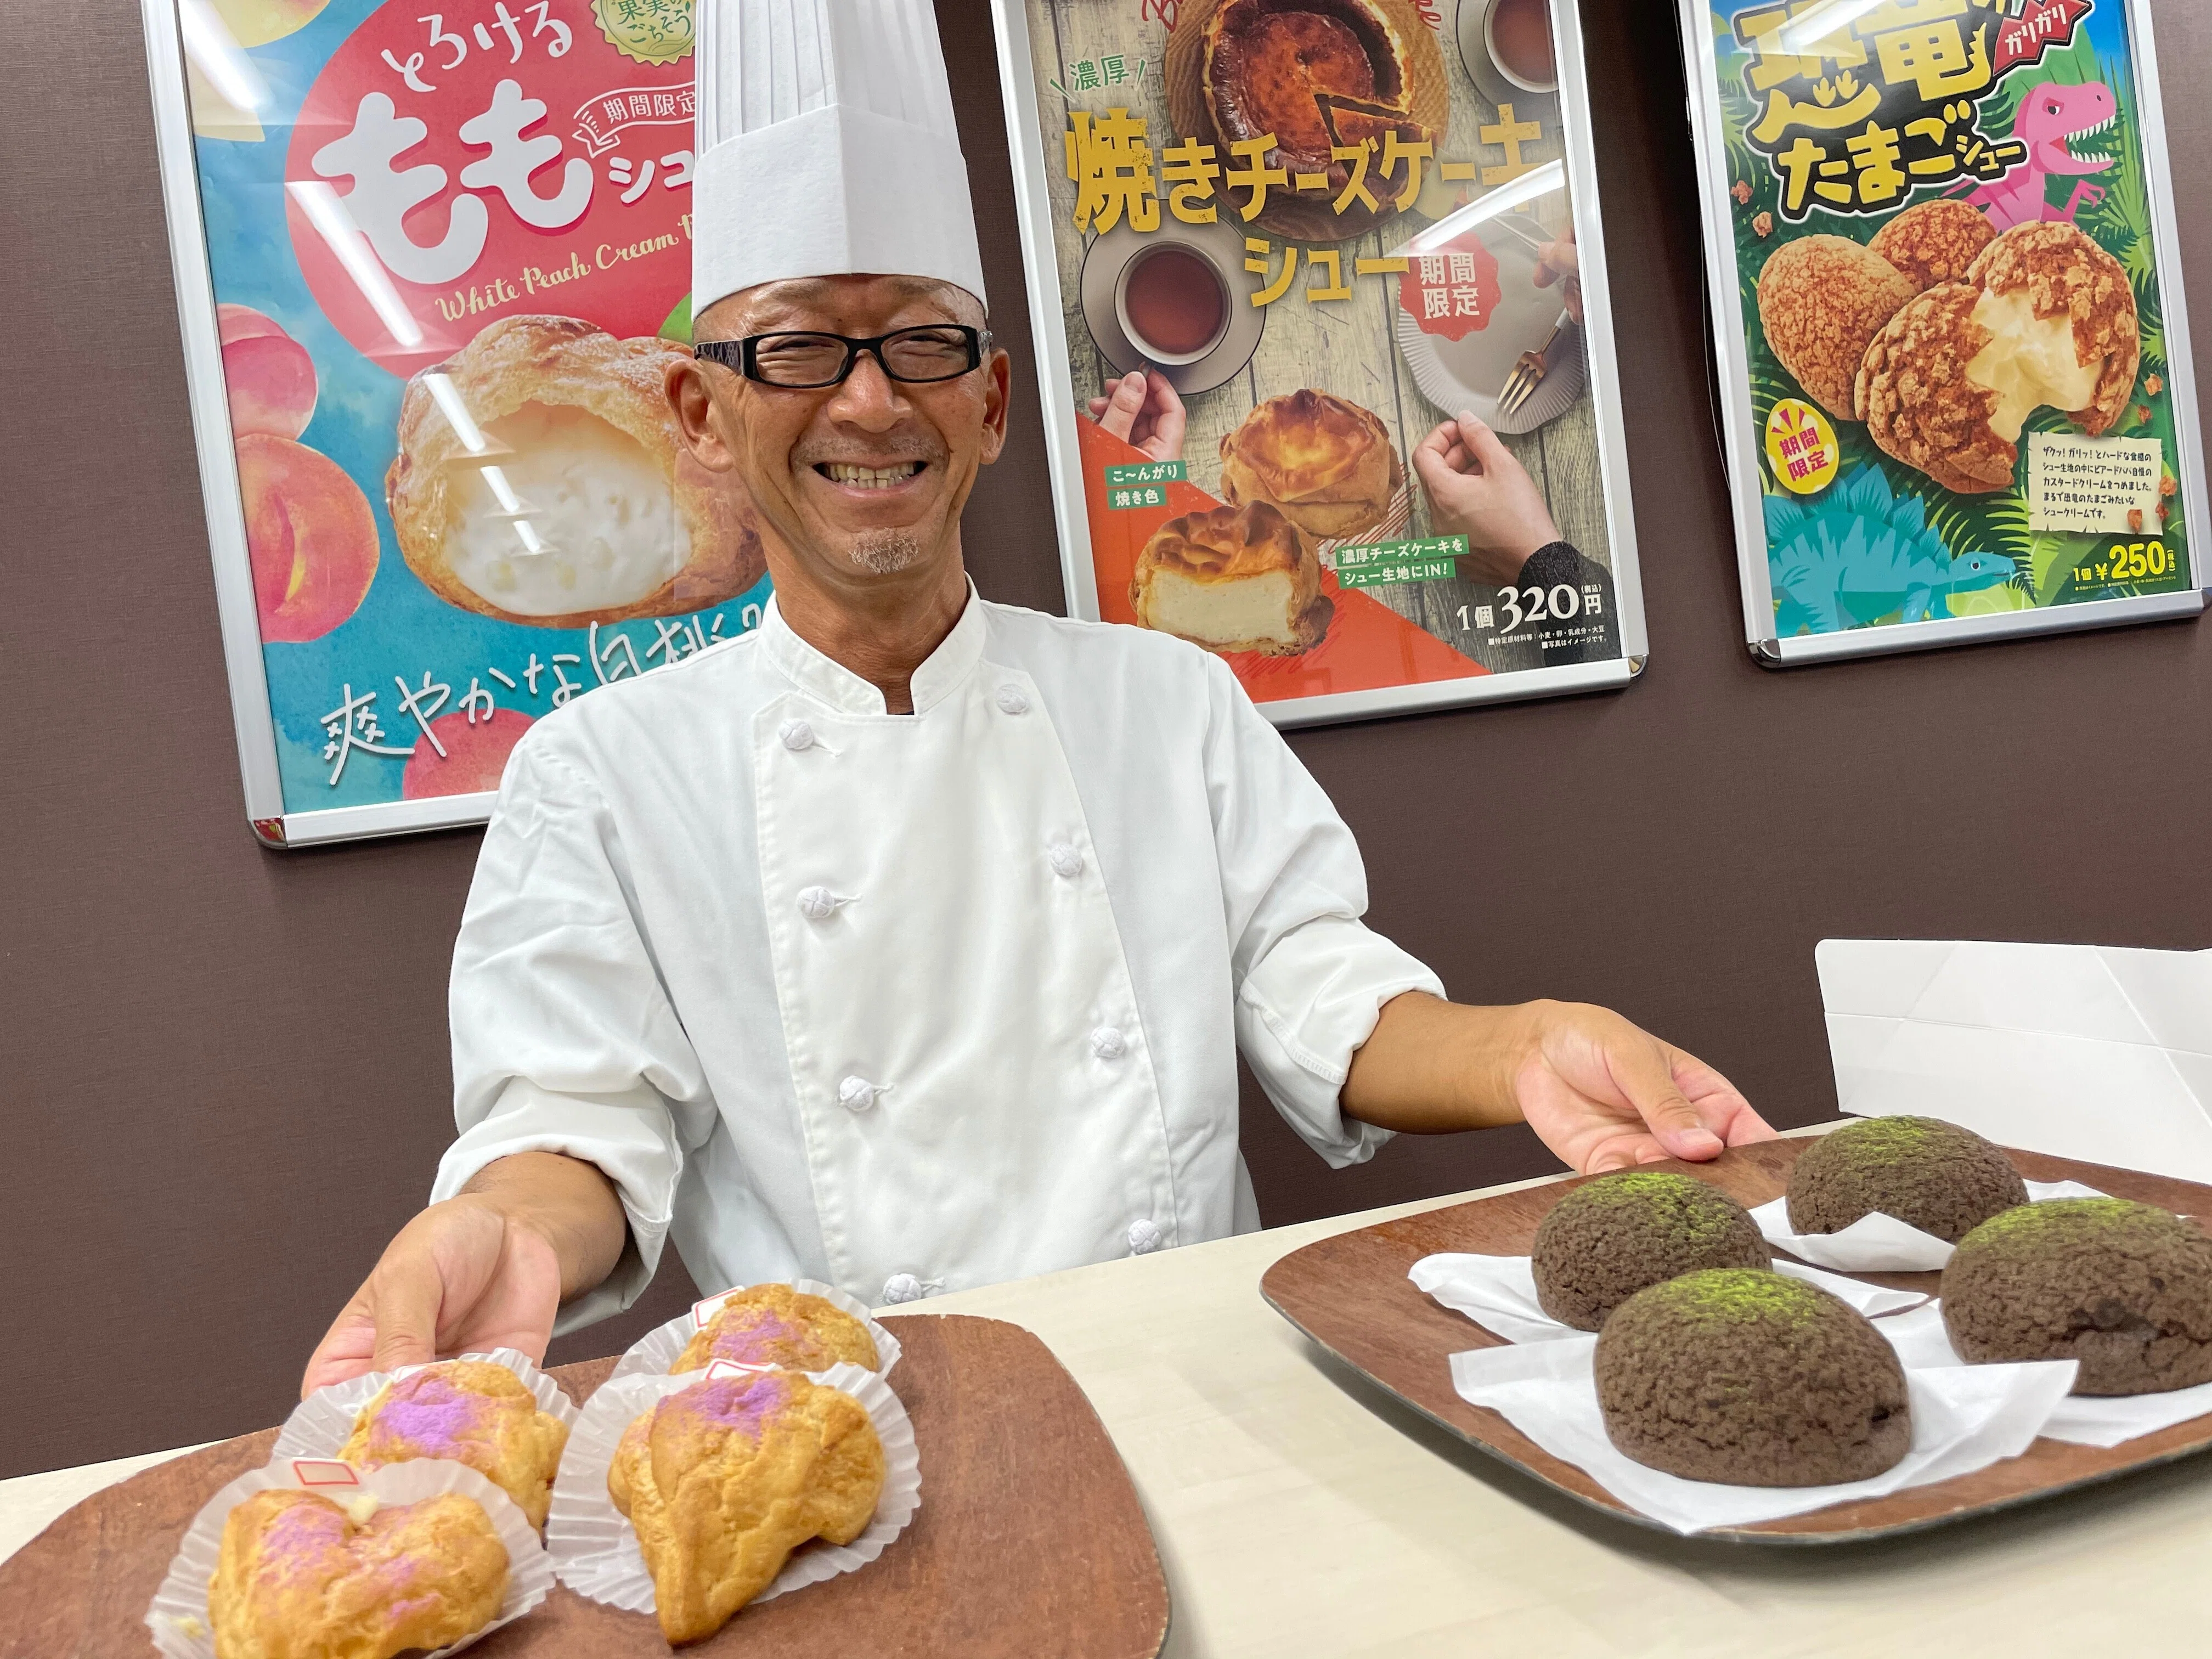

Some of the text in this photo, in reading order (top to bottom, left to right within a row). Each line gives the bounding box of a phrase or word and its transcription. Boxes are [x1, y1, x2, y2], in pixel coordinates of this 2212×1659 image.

[627, 10, 691, 43] ごちそう
[2005, 3, 2067, 55] ガリガリ
[381, 0, 572, 93] とろける
[1069, 54, 1130, 91] 濃厚
[602, 90, 696, 125] 期間限定
[311, 78, 595, 285] もも
[1064, 102, 1549, 235] 焼きチーズケーキ
[435, 233, 679, 323] White Peach Cream
[1244, 237, 1410, 308] シュー
[1418, 252, 1477, 286] 期間
[1422, 285, 1481, 320] 限定
[1779, 426, 1820, 460] 期間
[1787, 450, 1829, 482] 限定
[1115, 488, 1160, 507] 焼き色
[2043, 477, 2152, 492] カスタードクリームをつめました。
[2043, 492, 2135, 505] まるで恐竜のたまごみたいな
[2042, 507, 2106, 520] シュークリームです。
[1341, 538, 1464, 565] 濃厚チーズケーキを
[1344, 562, 1448, 586] シュー生地にIN!
